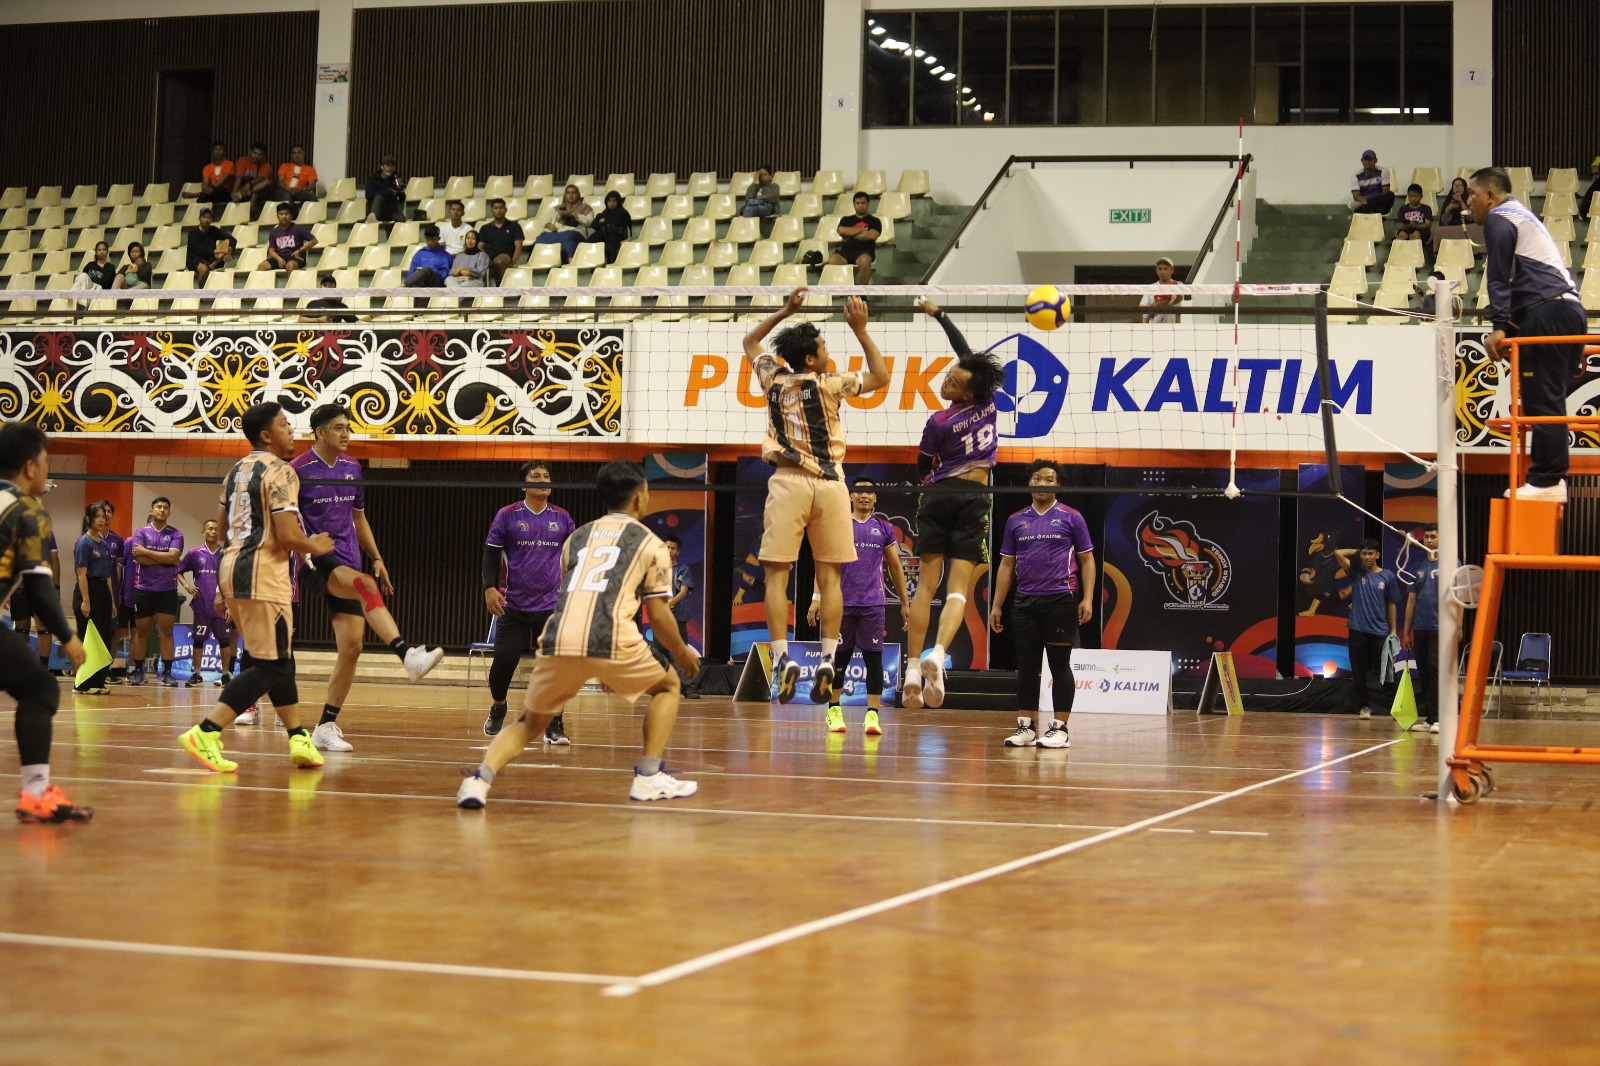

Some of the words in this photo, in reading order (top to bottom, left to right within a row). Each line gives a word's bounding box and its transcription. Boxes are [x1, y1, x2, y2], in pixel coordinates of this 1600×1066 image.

[1469, 71, 1476, 81] 7
[328, 94, 334, 103] 8
[838, 98, 844, 107] 8
[1111, 210, 1140, 222] EXIT
[684, 354, 966, 411] PUUK
[1091, 357, 1373, 414] KALTIM
[969, 402, 996, 424] PELANG
[567, 545, 622, 593] 12
[196, 625, 208, 636] 27
[1114, 681, 1160, 692] KALTIM
